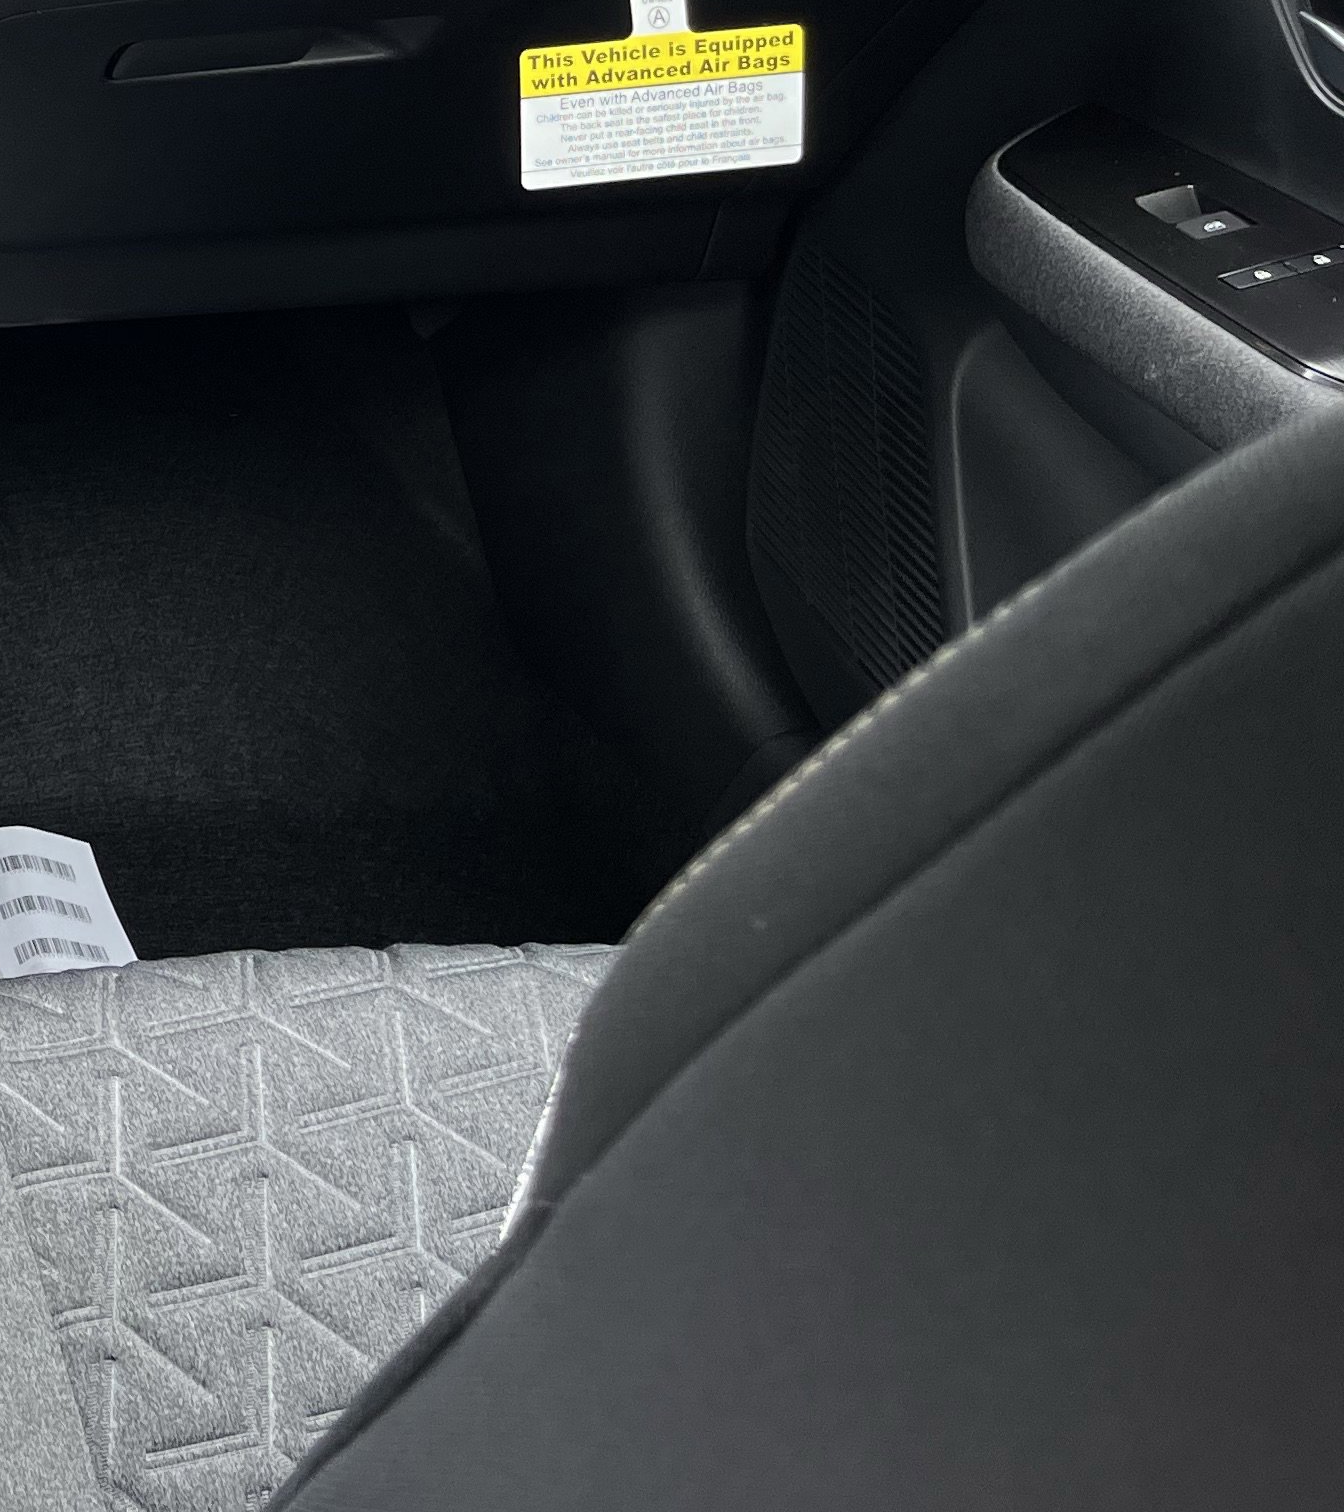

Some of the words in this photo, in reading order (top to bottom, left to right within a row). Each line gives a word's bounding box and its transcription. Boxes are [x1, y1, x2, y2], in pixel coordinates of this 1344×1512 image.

[652, 9, 666, 25] A
[528, 54, 573, 70] This
[581, 45, 660, 65] Vehicle
[669, 42, 686, 57] is
[695, 31, 793, 55] Equipped
[532, 73, 578, 89] with
[586, 61, 691, 85] Advanced
[699, 59, 730, 74] Air
[738, 55, 790, 71] Bags
[536, 113, 573, 123] Children
[595, 109, 606, 118] be
[609, 105, 632, 116] killed
[635, 106, 644, 114] or
[647, 101, 686, 113] seriously
[689, 98, 720, 109] injured
[723, 96, 733, 106] by
[736, 95, 750, 104] the
[753, 94, 764, 102] air
[560, 97, 594, 110] Even
[600, 93, 627, 106] with
[632, 86, 700, 102] Advanced
[704, 84, 724, 96] Air
[728, 81, 763, 94] Bags
[560, 123, 577, 132] The
[581, 121, 601, 130] back
[604, 119, 623, 127] seat
[626, 117, 634, 126] is
[636, 115, 650, 124] the
[653, 112, 680, 123] safest
[683, 110, 706, 121] place
[709, 108, 721, 117] for
[560, 134, 587, 143] Never
[590, 131, 604, 142] put
[615, 125, 663, 137] rear-facing
[666, 123, 687, 132] child
[690, 121, 708, 130] seat
[711, 119, 719, 128] in
[722, 118, 736, 127] the
[568, 143, 599, 154] Always
[602, 140, 618, 149] use
[621, 138, 640, 147] seat
[643, 135, 664, 145] belts
[668, 133, 683, 143] and
[686, 131, 707, 141] child
